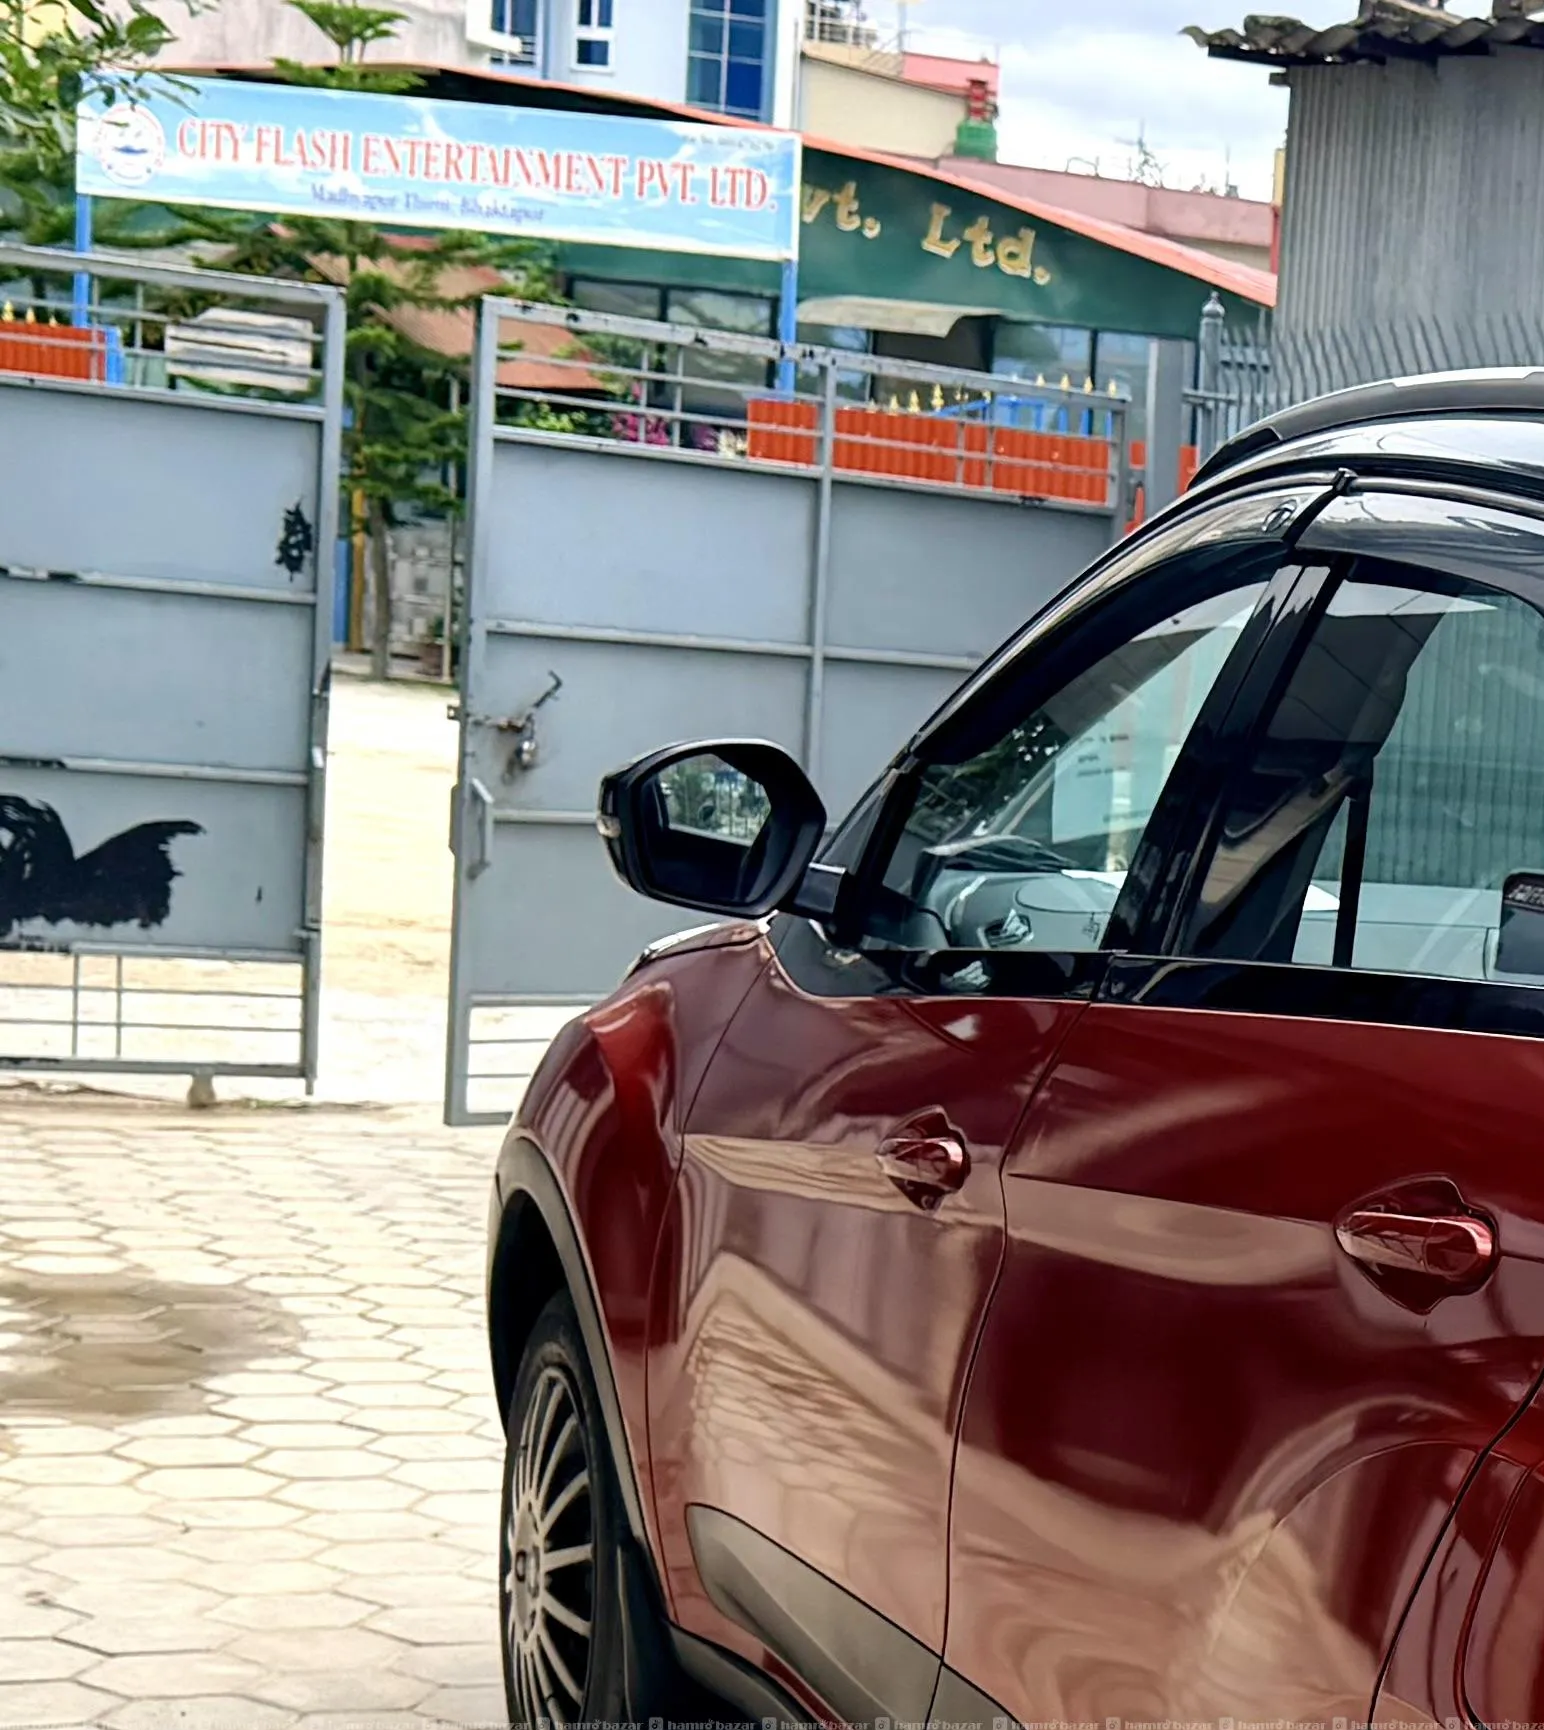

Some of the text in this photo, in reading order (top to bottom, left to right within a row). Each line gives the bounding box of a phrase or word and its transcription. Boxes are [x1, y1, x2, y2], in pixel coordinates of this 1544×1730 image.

[178, 120, 243, 162] CITY
[256, 125, 349, 172] FLASH
[362, 135, 626, 196] ENTERTAINMENT
[711, 166, 777, 211] LTD.
[801, 180, 1052, 286] vt. Ltd.
